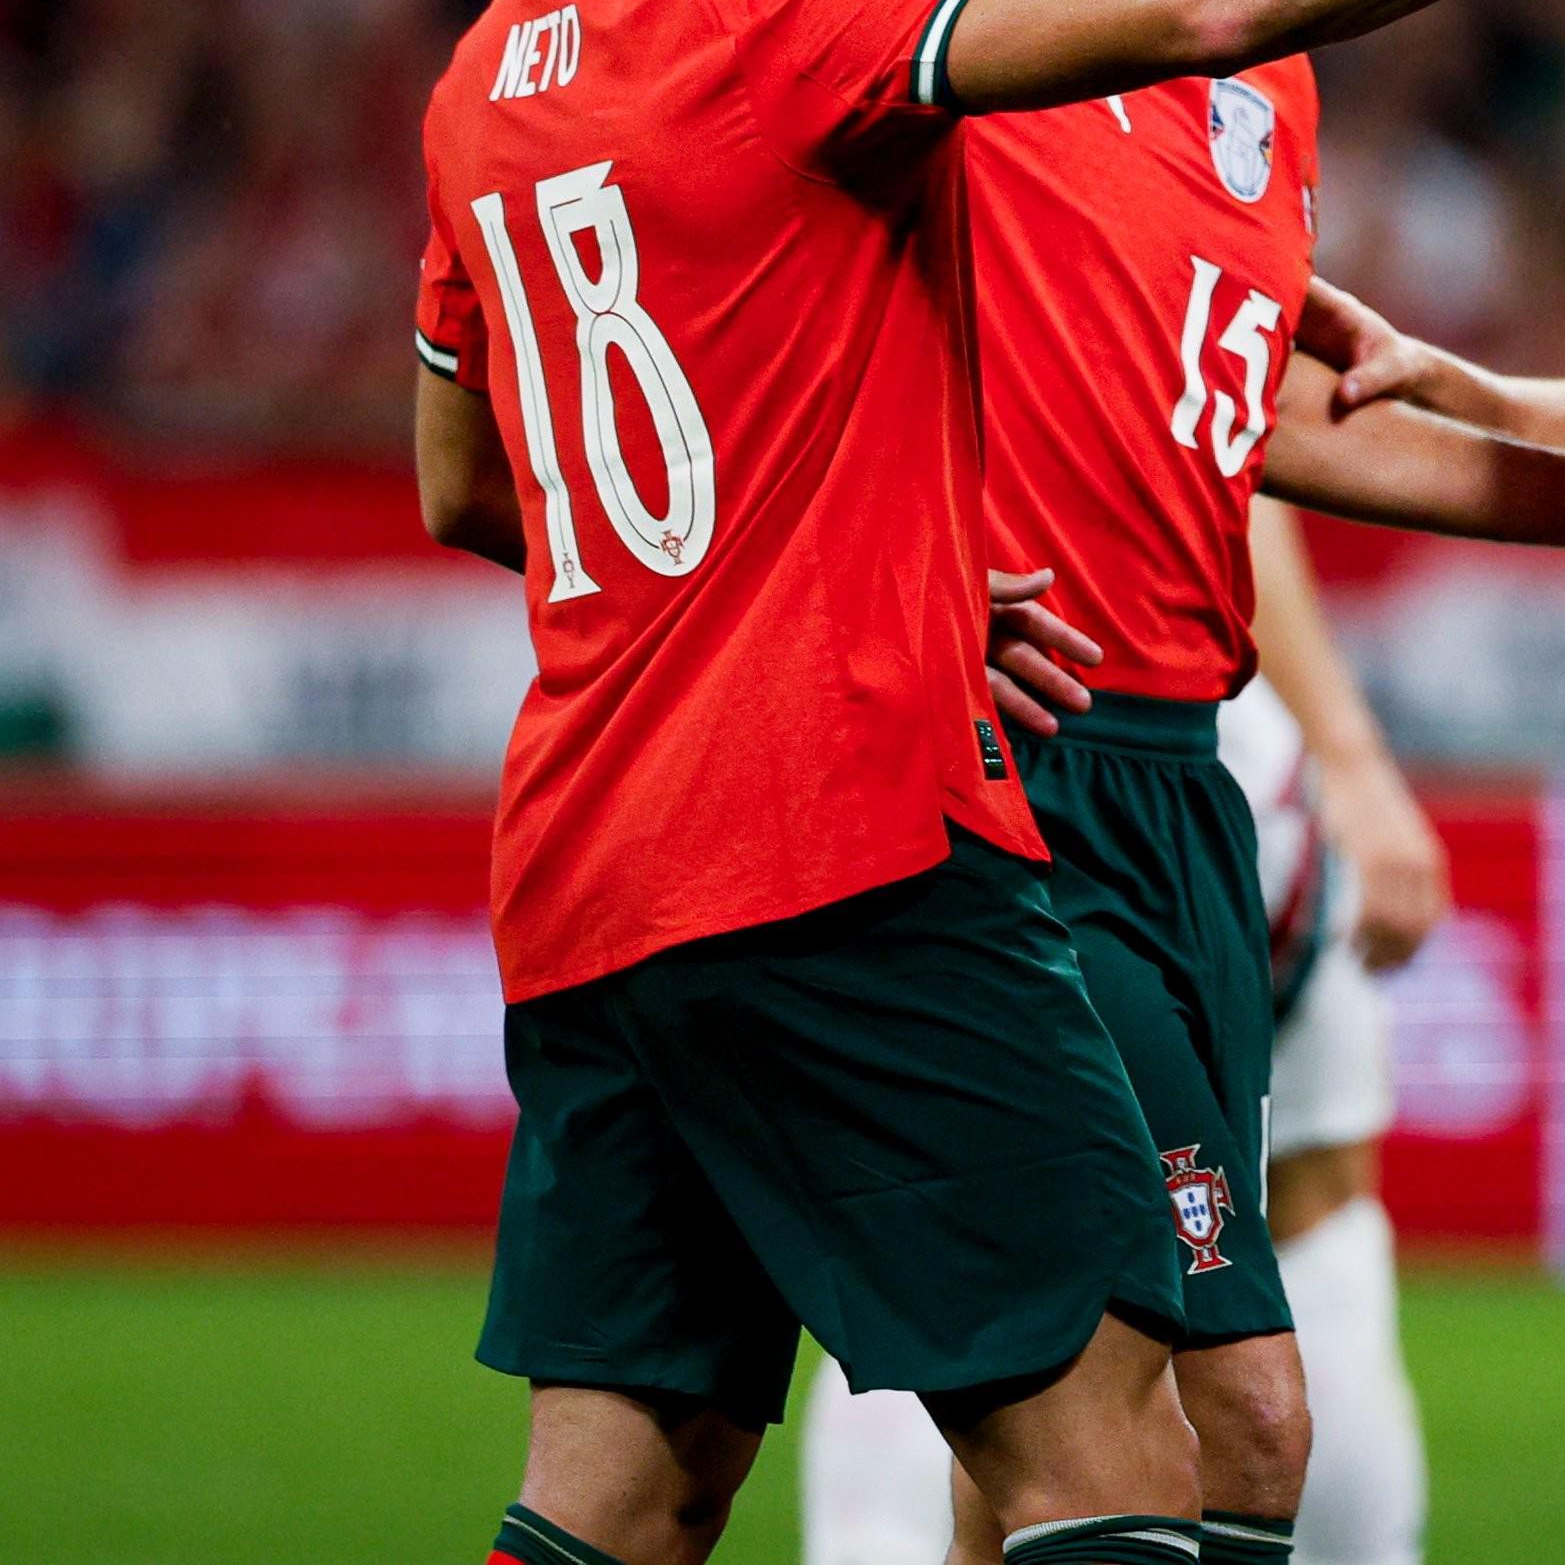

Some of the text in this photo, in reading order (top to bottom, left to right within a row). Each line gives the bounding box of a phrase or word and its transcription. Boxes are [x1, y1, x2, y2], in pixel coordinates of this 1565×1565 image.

[488, 3, 582, 102] NETO
[470, 159, 716, 604] 18
[1169, 254, 1283, 479] 15
